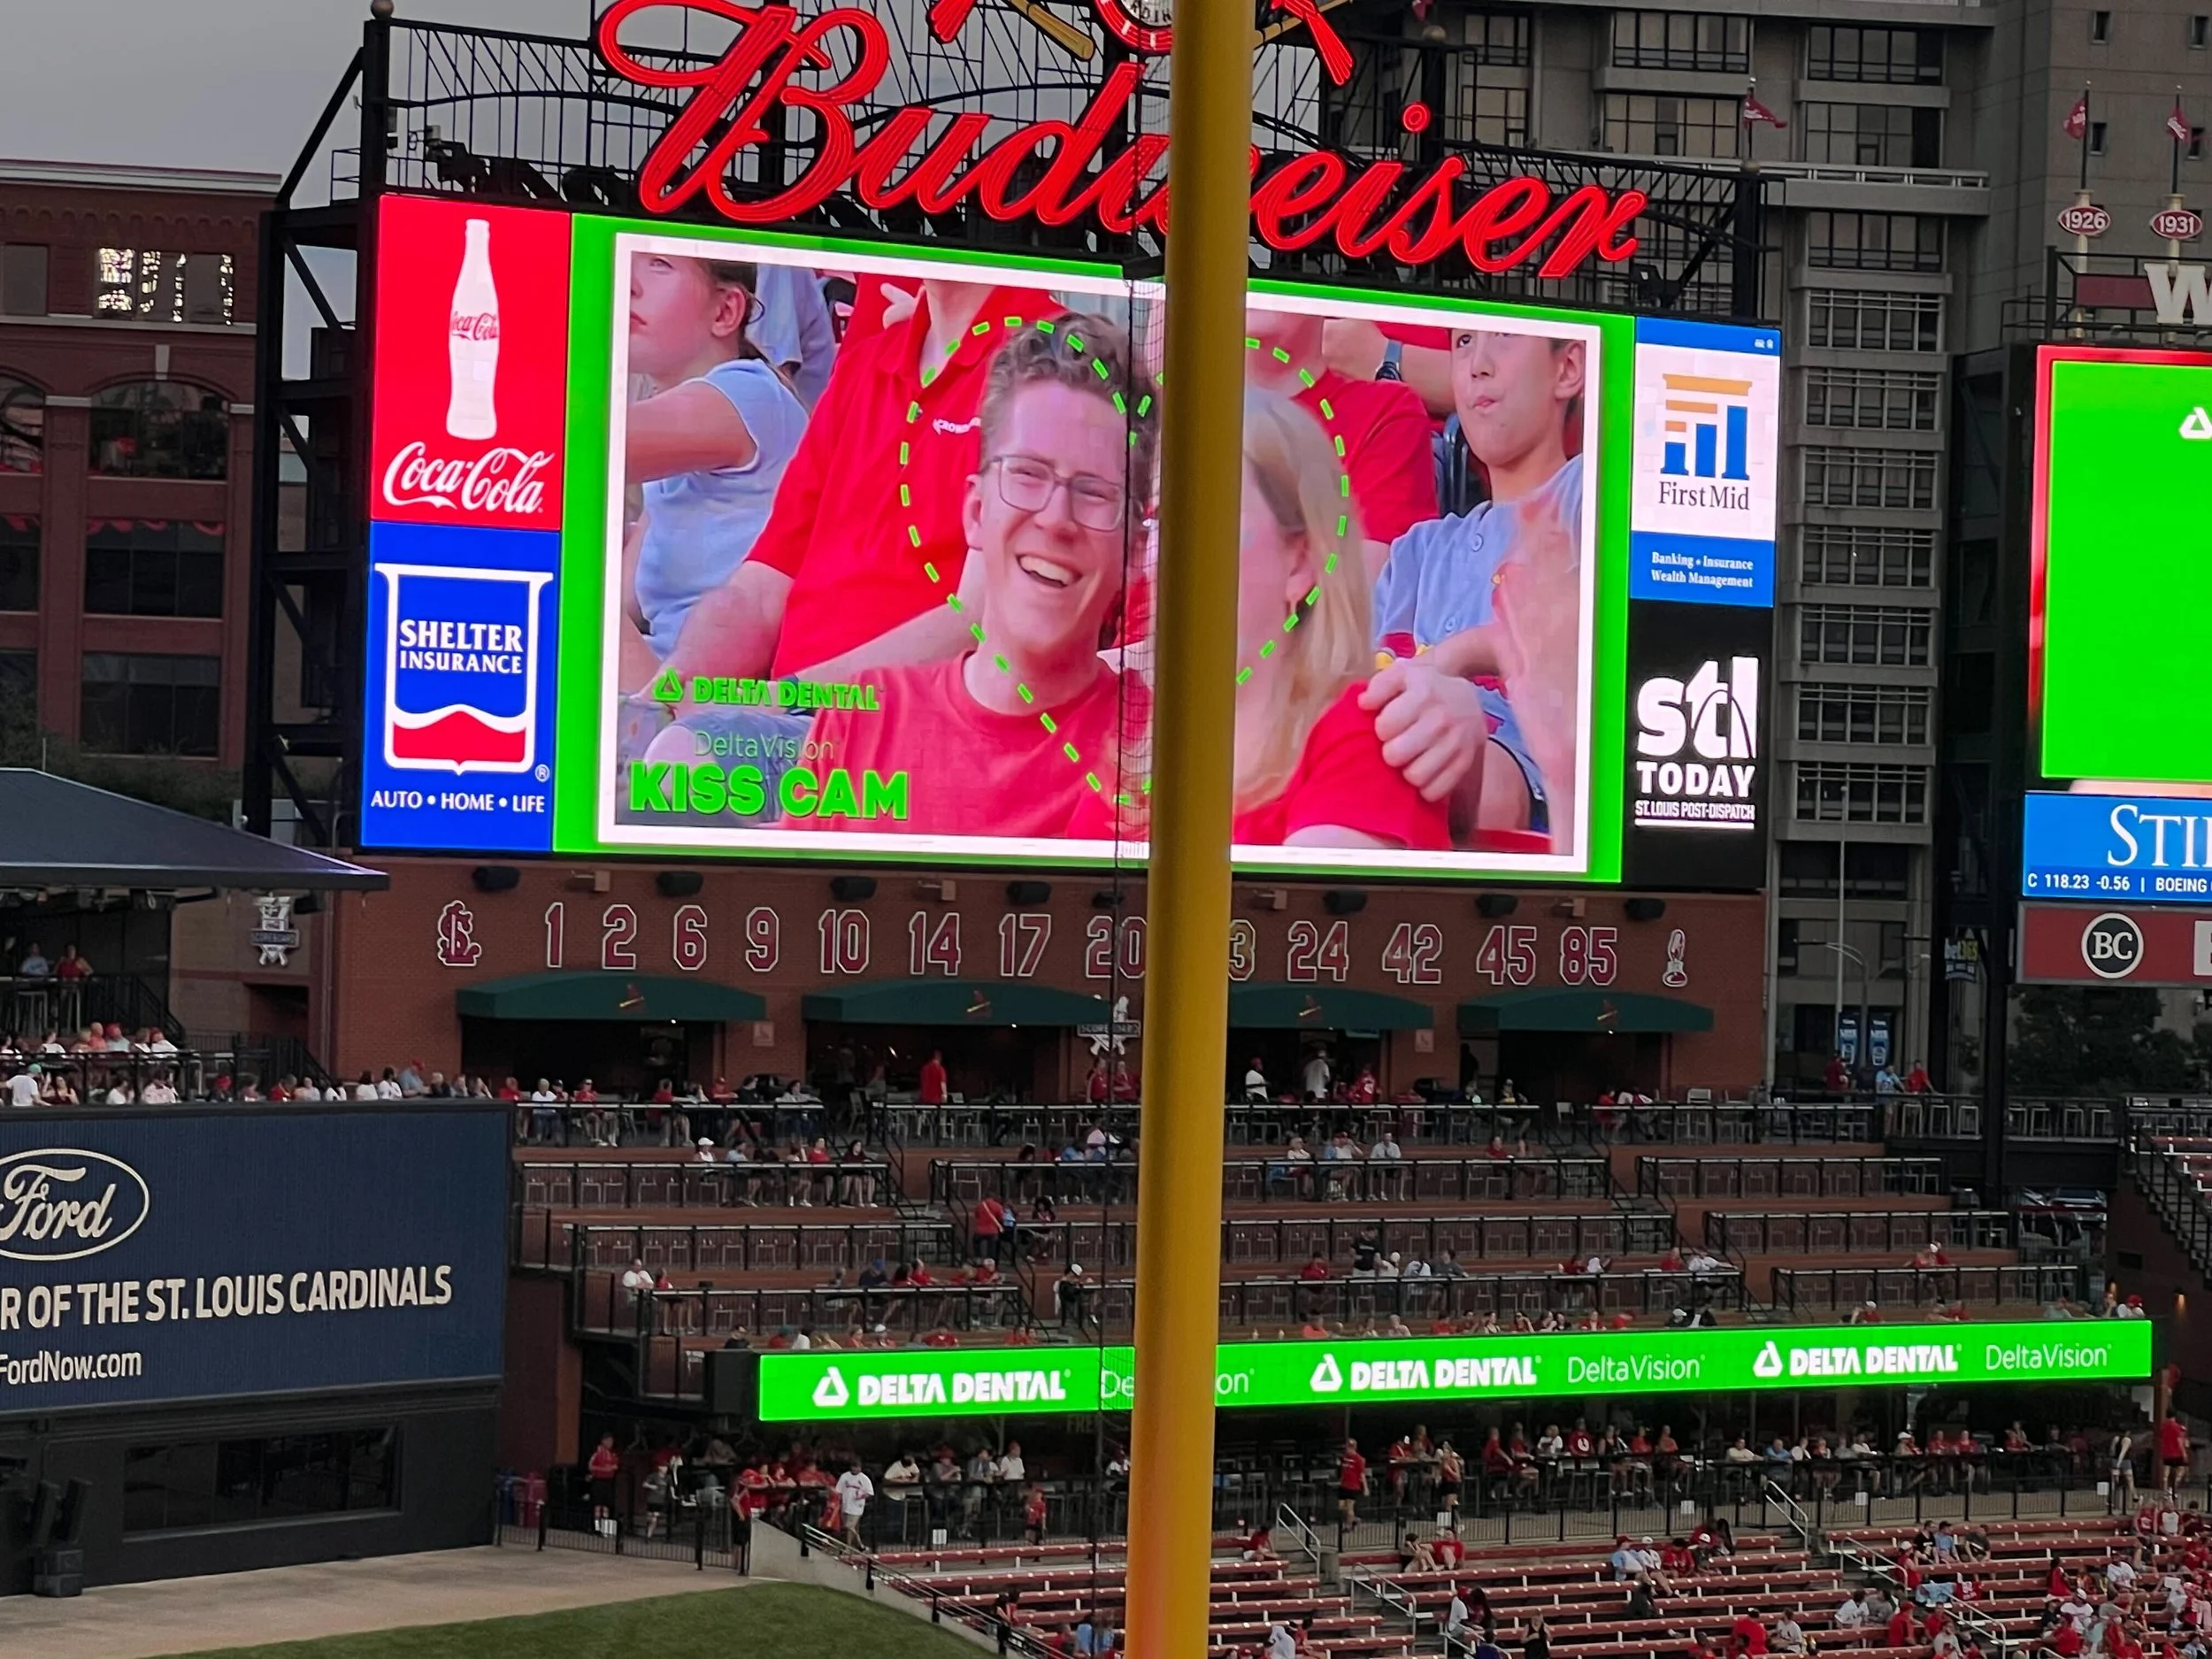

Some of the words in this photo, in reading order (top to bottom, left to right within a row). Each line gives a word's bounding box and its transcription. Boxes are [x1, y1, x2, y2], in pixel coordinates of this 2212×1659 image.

[2064, 210, 2107, 231] 1926
[2158, 215, 2196, 235] 1931
[383, 442, 554, 513] Coca-Cola
[1659, 480, 1707, 507] First
[1709, 485, 1750, 511] Mid
[1652, 551, 1694, 569] Banking
[1703, 555, 1754, 570] Insurance
[1651, 569, 1686, 583] Wealth
[1688, 572, 1754, 588] Management
[399, 618, 524, 652] SHELTER
[400, 650, 523, 674] INSURANCE
[692, 676, 772, 706] DELTA
[778, 680, 879, 710] DENTAL
[1637, 656, 1759, 759] stl
[694, 730, 833, 761] DeltaVision
[629, 760, 765, 816] KISS
[779, 766, 909, 820] CAM
[1636, 761, 1756, 798] TODAY
[371, 790, 423, 809] AUTO
[441, 793, 494, 811] HOME
[512, 795, 545, 813] LIFE
[1651, 801, 1680, 818] LOUIS
[1681, 802, 1755, 821] POST-DISPATCH
[2027, 873, 2038, 887] C
[2045, 874, 2090, 889] 118.23
[2096, 875, 2131, 891] -0.56
[2155, 877, 2208, 893] BOEING
[544, 902, 564, 968] 1
[602, 903, 637, 971] 2
[672, 904, 708, 971] 6
[745, 906, 780, 972] 9
[818, 909, 870, 974] 10
[909, 910, 962, 976] 14
[998, 913, 1052, 977] 17
[1085, 915, 1148, 979] 20
[1228, 919, 1256, 981] 3
[1287, 920, 1349, 982] 24
[1381, 923, 1442, 984] 42
[1476, 926, 1538, 986] 45
[1559, 926, 1617, 986] 85
[2092, 931, 2133, 961] BC
[0, 1164, 117, 1240] Ford
[27, 1285, 73, 1328] OF
[77, 1280, 141, 1325] THE
[145, 1279, 189, 1322] ST.
[196, 1272, 285, 1319] LOUIS
[288, 1264, 452, 1314] CARDINALS
[1350, 1359, 1431, 1391] DELTA
[1434, 1356, 1538, 1388] DENTAL
[1567, 1355, 1701, 1383] DeltaVision
[1789, 1347, 1861, 1376] DELTA
[1865, 1344, 1958, 1373] DENTAL
[1985, 1342, 2108, 1371] DeltaVision
[857, 1374, 946, 1405] DELTA
[951, 1371, 1066, 1402] DENTAL
